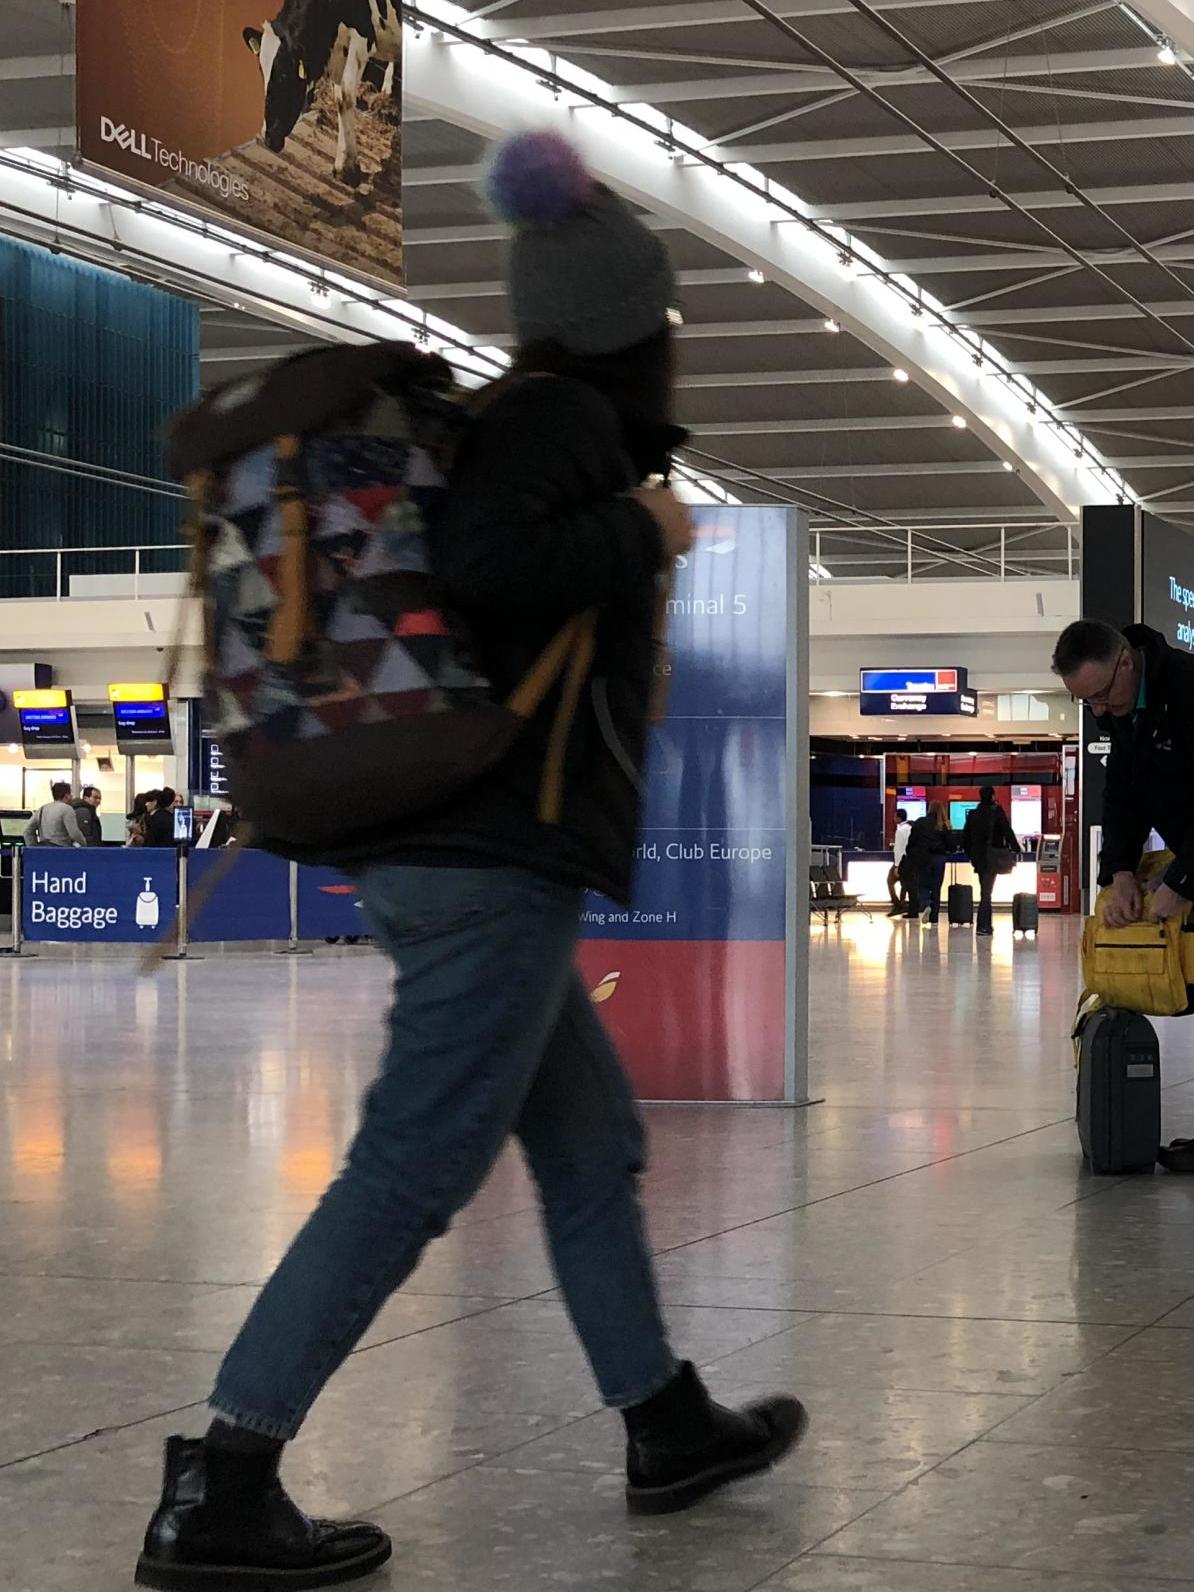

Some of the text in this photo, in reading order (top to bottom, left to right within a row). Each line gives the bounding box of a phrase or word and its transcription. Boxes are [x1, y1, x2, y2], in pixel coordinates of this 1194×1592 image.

[101, 115, 249, 200] DELL Technologies
[1169, 576, 1181, 602] The
[665, 593, 748, 615] minal 5
[633, 843, 772, 864] rld, Club Europe
[32, 871, 87, 893] Hand
[31, 900, 118, 929] Baggage
[578, 910, 677, 925] Wing and Zone H
